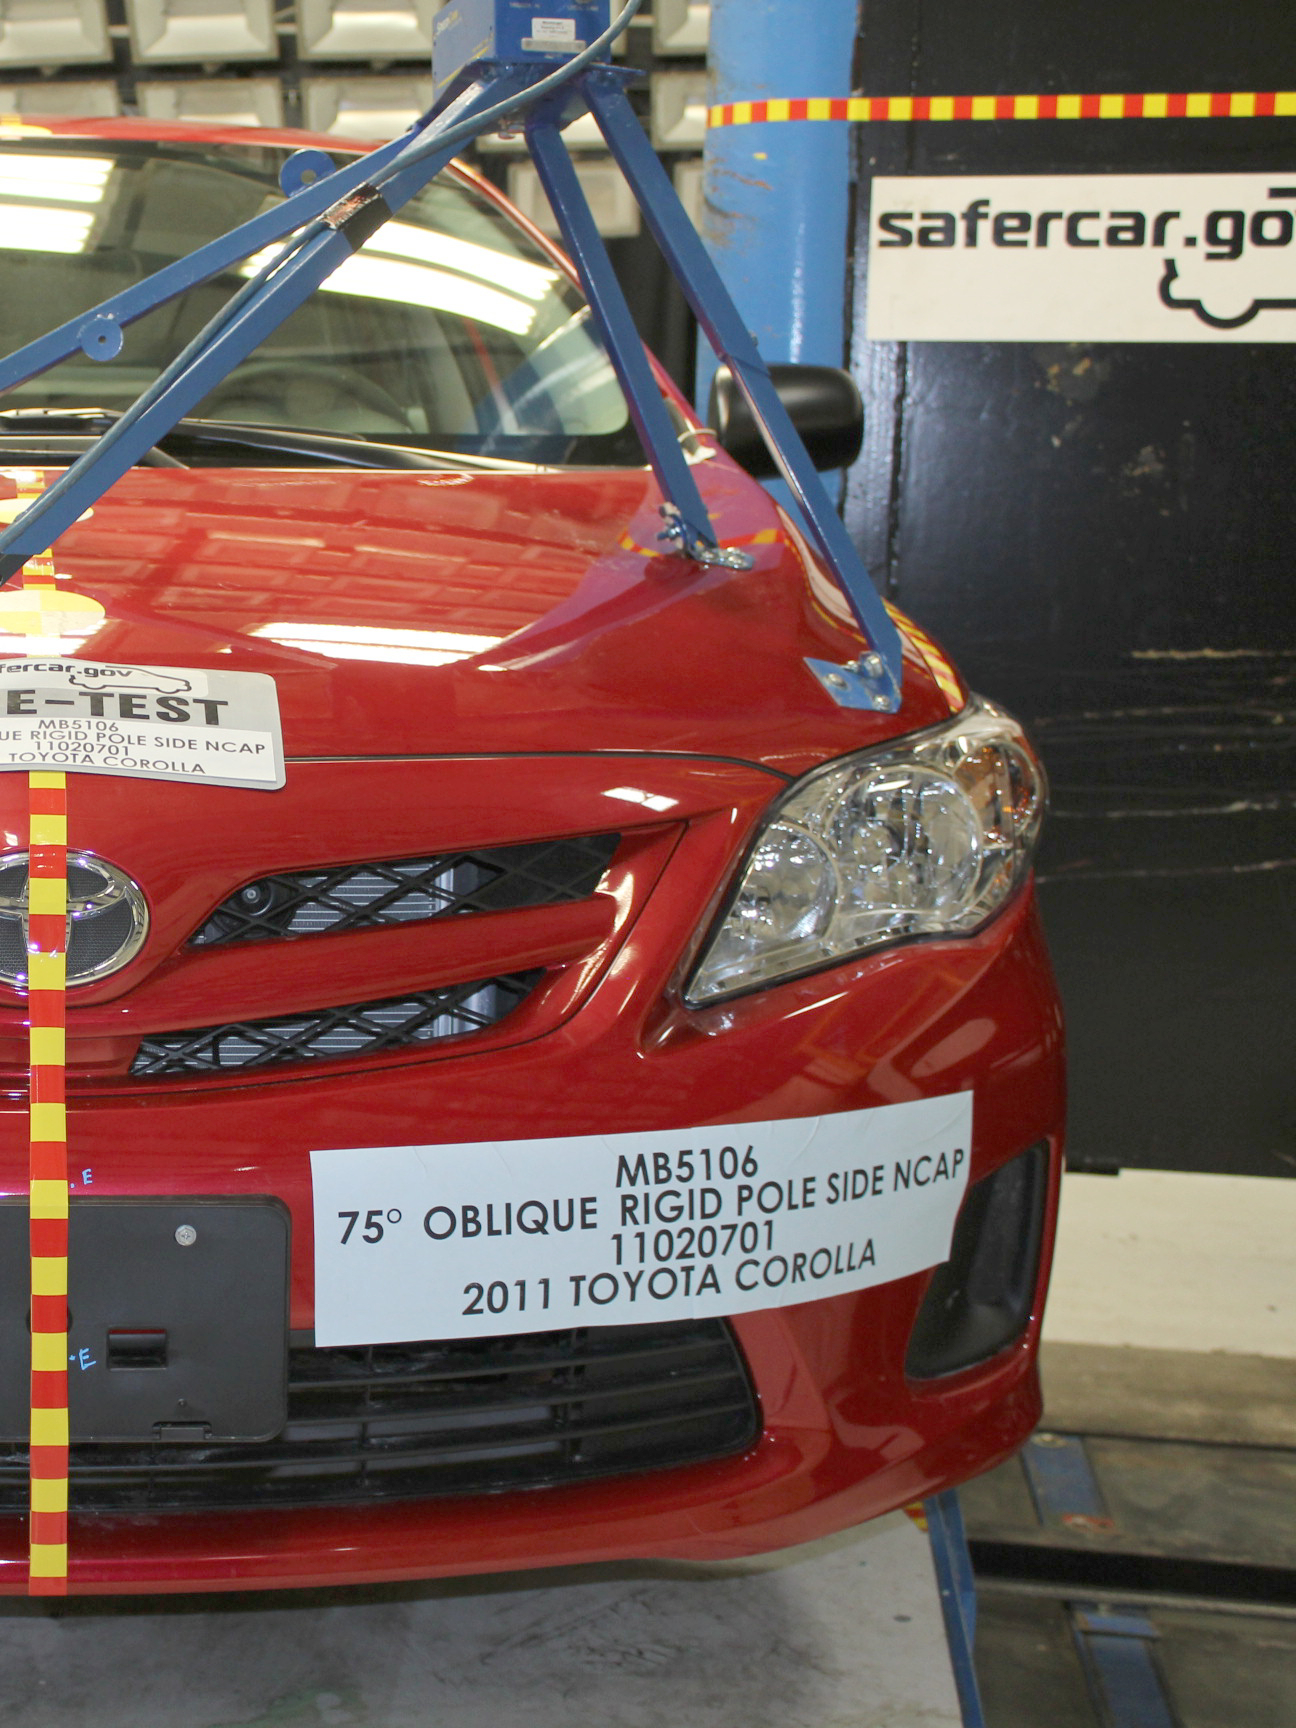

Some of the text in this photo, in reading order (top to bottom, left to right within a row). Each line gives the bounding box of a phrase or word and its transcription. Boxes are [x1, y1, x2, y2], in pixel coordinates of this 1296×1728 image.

[877, 198, 1296, 260] safercar.go
[30, 729, 88, 742] RIGID
[96, 732, 147, 745] POLE
[154, 735, 198, 749] SIDE
[205, 740, 265, 754] NCAP
[38, 719, 119, 731] MB5106
[8, 752, 96, 764] TOYOTA
[103, 757, 206, 773] COROLLA
[34, 742, 129, 755] 11020701
[615, 1144, 759, 1188] MB5106
[422, 1196, 597, 1242] OBLIQUE
[620, 1186, 723, 1227] RIGID
[737, 1174, 815, 1218] POLE
[825, 1164, 886, 1205] SIDE
[894, 1147, 965, 1192] NCAP
[610, 1218, 774, 1266] 11020701
[461, 1237, 877, 1316] 2011 TOYOTA COROLLA
